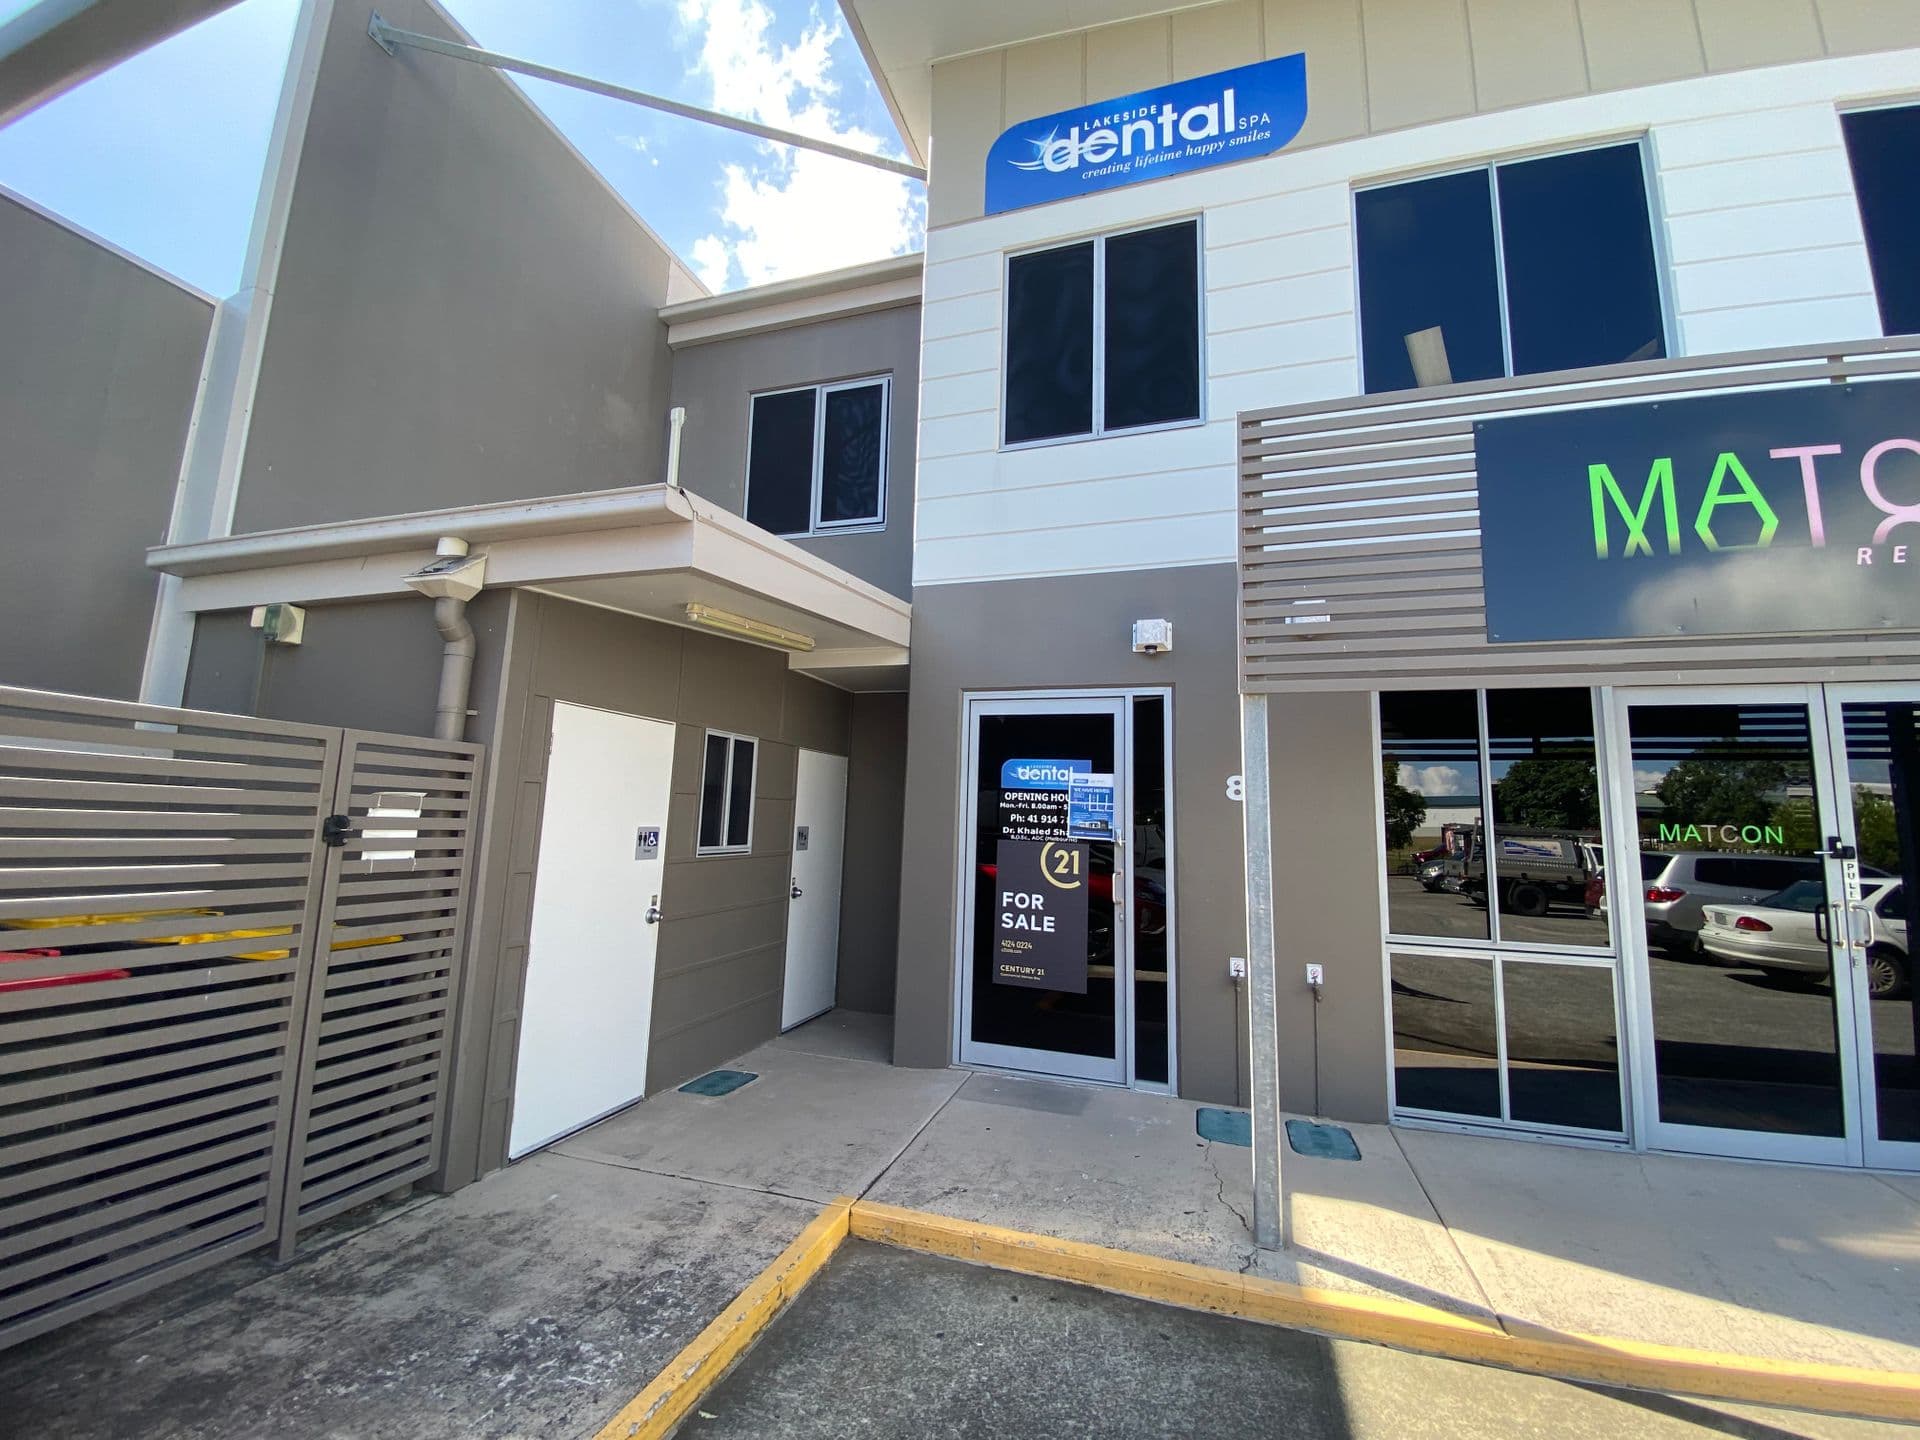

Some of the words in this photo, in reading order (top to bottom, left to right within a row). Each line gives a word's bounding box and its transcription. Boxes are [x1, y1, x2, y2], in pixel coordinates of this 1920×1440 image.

[1084, 104, 1157, 131] LAKESIDE
[1042, 88, 1236, 173] dental
[1239, 112, 1271, 131] SPA
[1082, 160, 1132, 180] creating
[1135, 149, 1182, 169] lifetime
[1185, 139, 1225, 157] happy
[1229, 128, 1271, 147] smiles
[1004, 791, 1049, 802] OPENING
[1226, 775, 1243, 801] 8
[1010, 813, 1025, 823] Ph:
[1027, 814, 1038, 823] 41
[1041, 814, 1058, 824] 914
[1002, 826, 1015, 834] Dr.
[1017, 826, 1050, 836] Khaled
[1659, 823, 1784, 844] MATCON
[1847, 863, 1857, 898] PULL
[1002, 891, 1044, 910] FOR
[1001, 912, 1056, 933] SALE
[1000, 964, 1036, 975] CENTURY
[1037, 968, 1045, 976] 21
